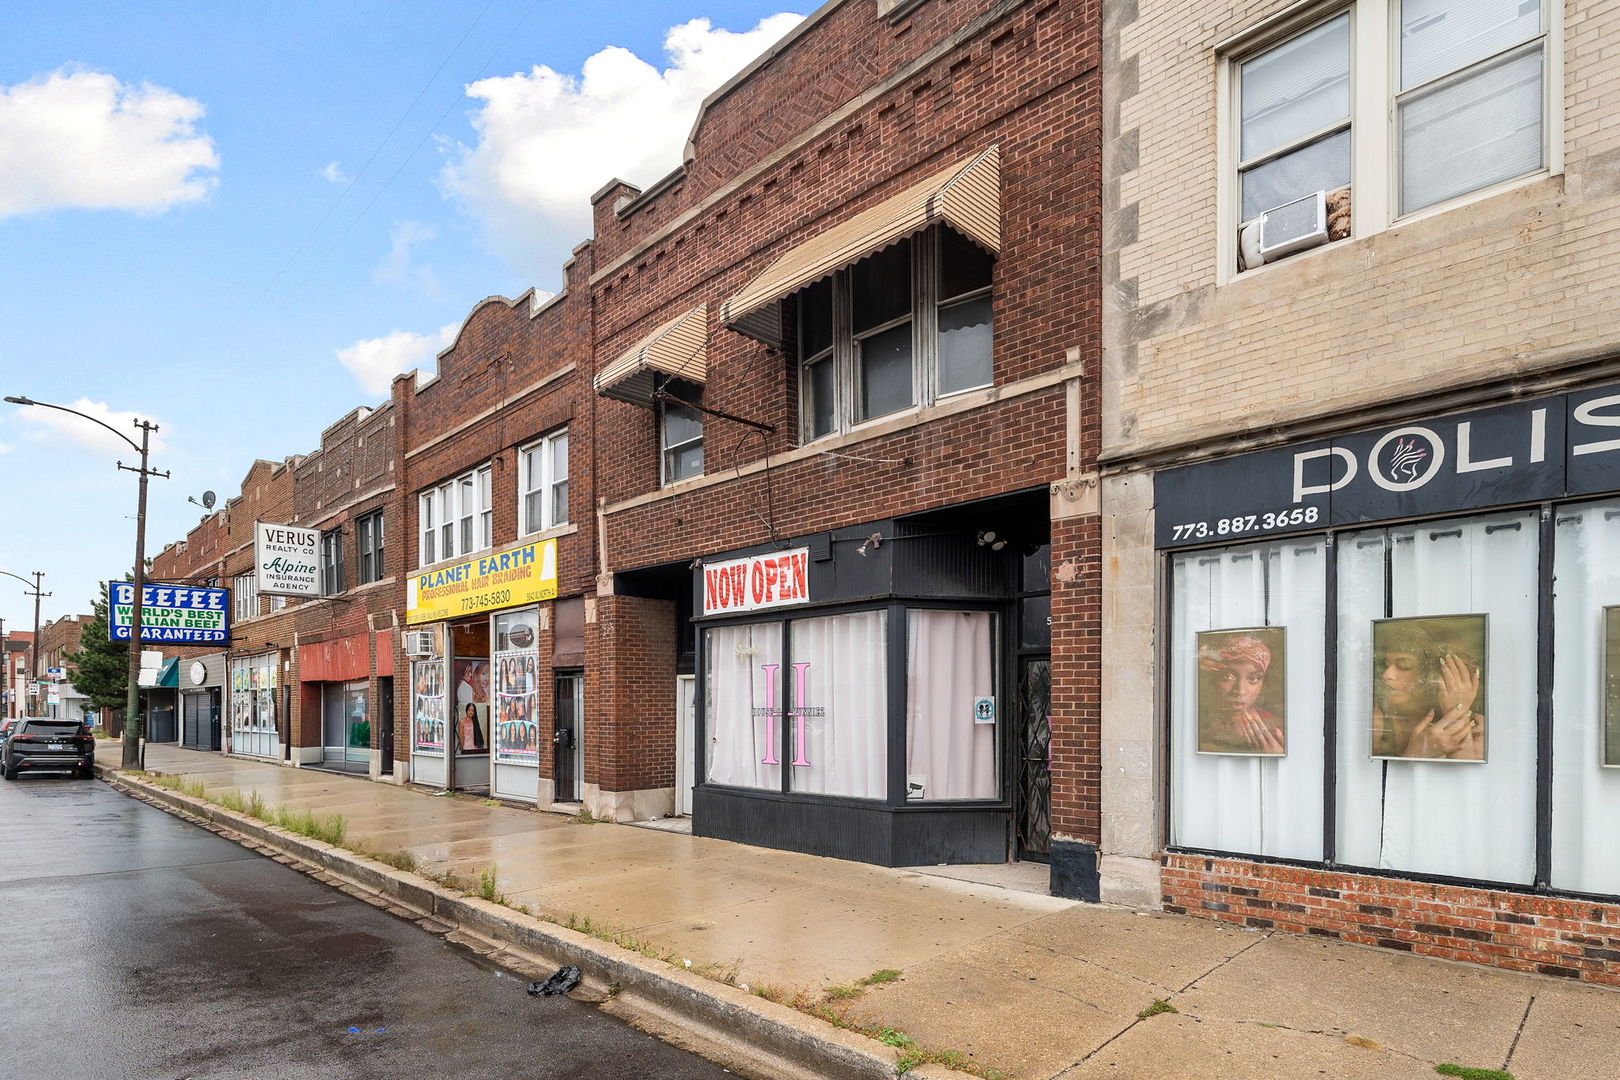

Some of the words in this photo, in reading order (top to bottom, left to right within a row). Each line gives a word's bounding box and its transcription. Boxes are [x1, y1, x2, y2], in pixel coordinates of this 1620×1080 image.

[1172, 506, 1319, 541] 773.887.3658
[265, 529, 316, 547] VERUS
[266, 544, 298, 553] REALTY
[263, 557, 317, 575] Alpine
[420, 563, 472, 590] PLANET
[479, 545, 535, 576] EARTH
[266, 574, 315, 583] INSURANCE
[273, 582, 309, 591] AGENCY
[421, 581, 469, 601] PROFESSIONAL
[471, 576, 489, 590] HAIR
[492, 565, 532, 585] BRAIDING
[705, 563, 747, 610] NOW
[751, 553, 807, 605] OPEN
[116, 585, 224, 610] BEEFEE
[461, 589, 511, 611] 773-745-5830
[117, 606, 183, 618] WRLD'S
[187, 609, 223, 620] BEST
[184, 619, 220, 629] BEEF
[116, 627, 225, 641] GARANTEED
